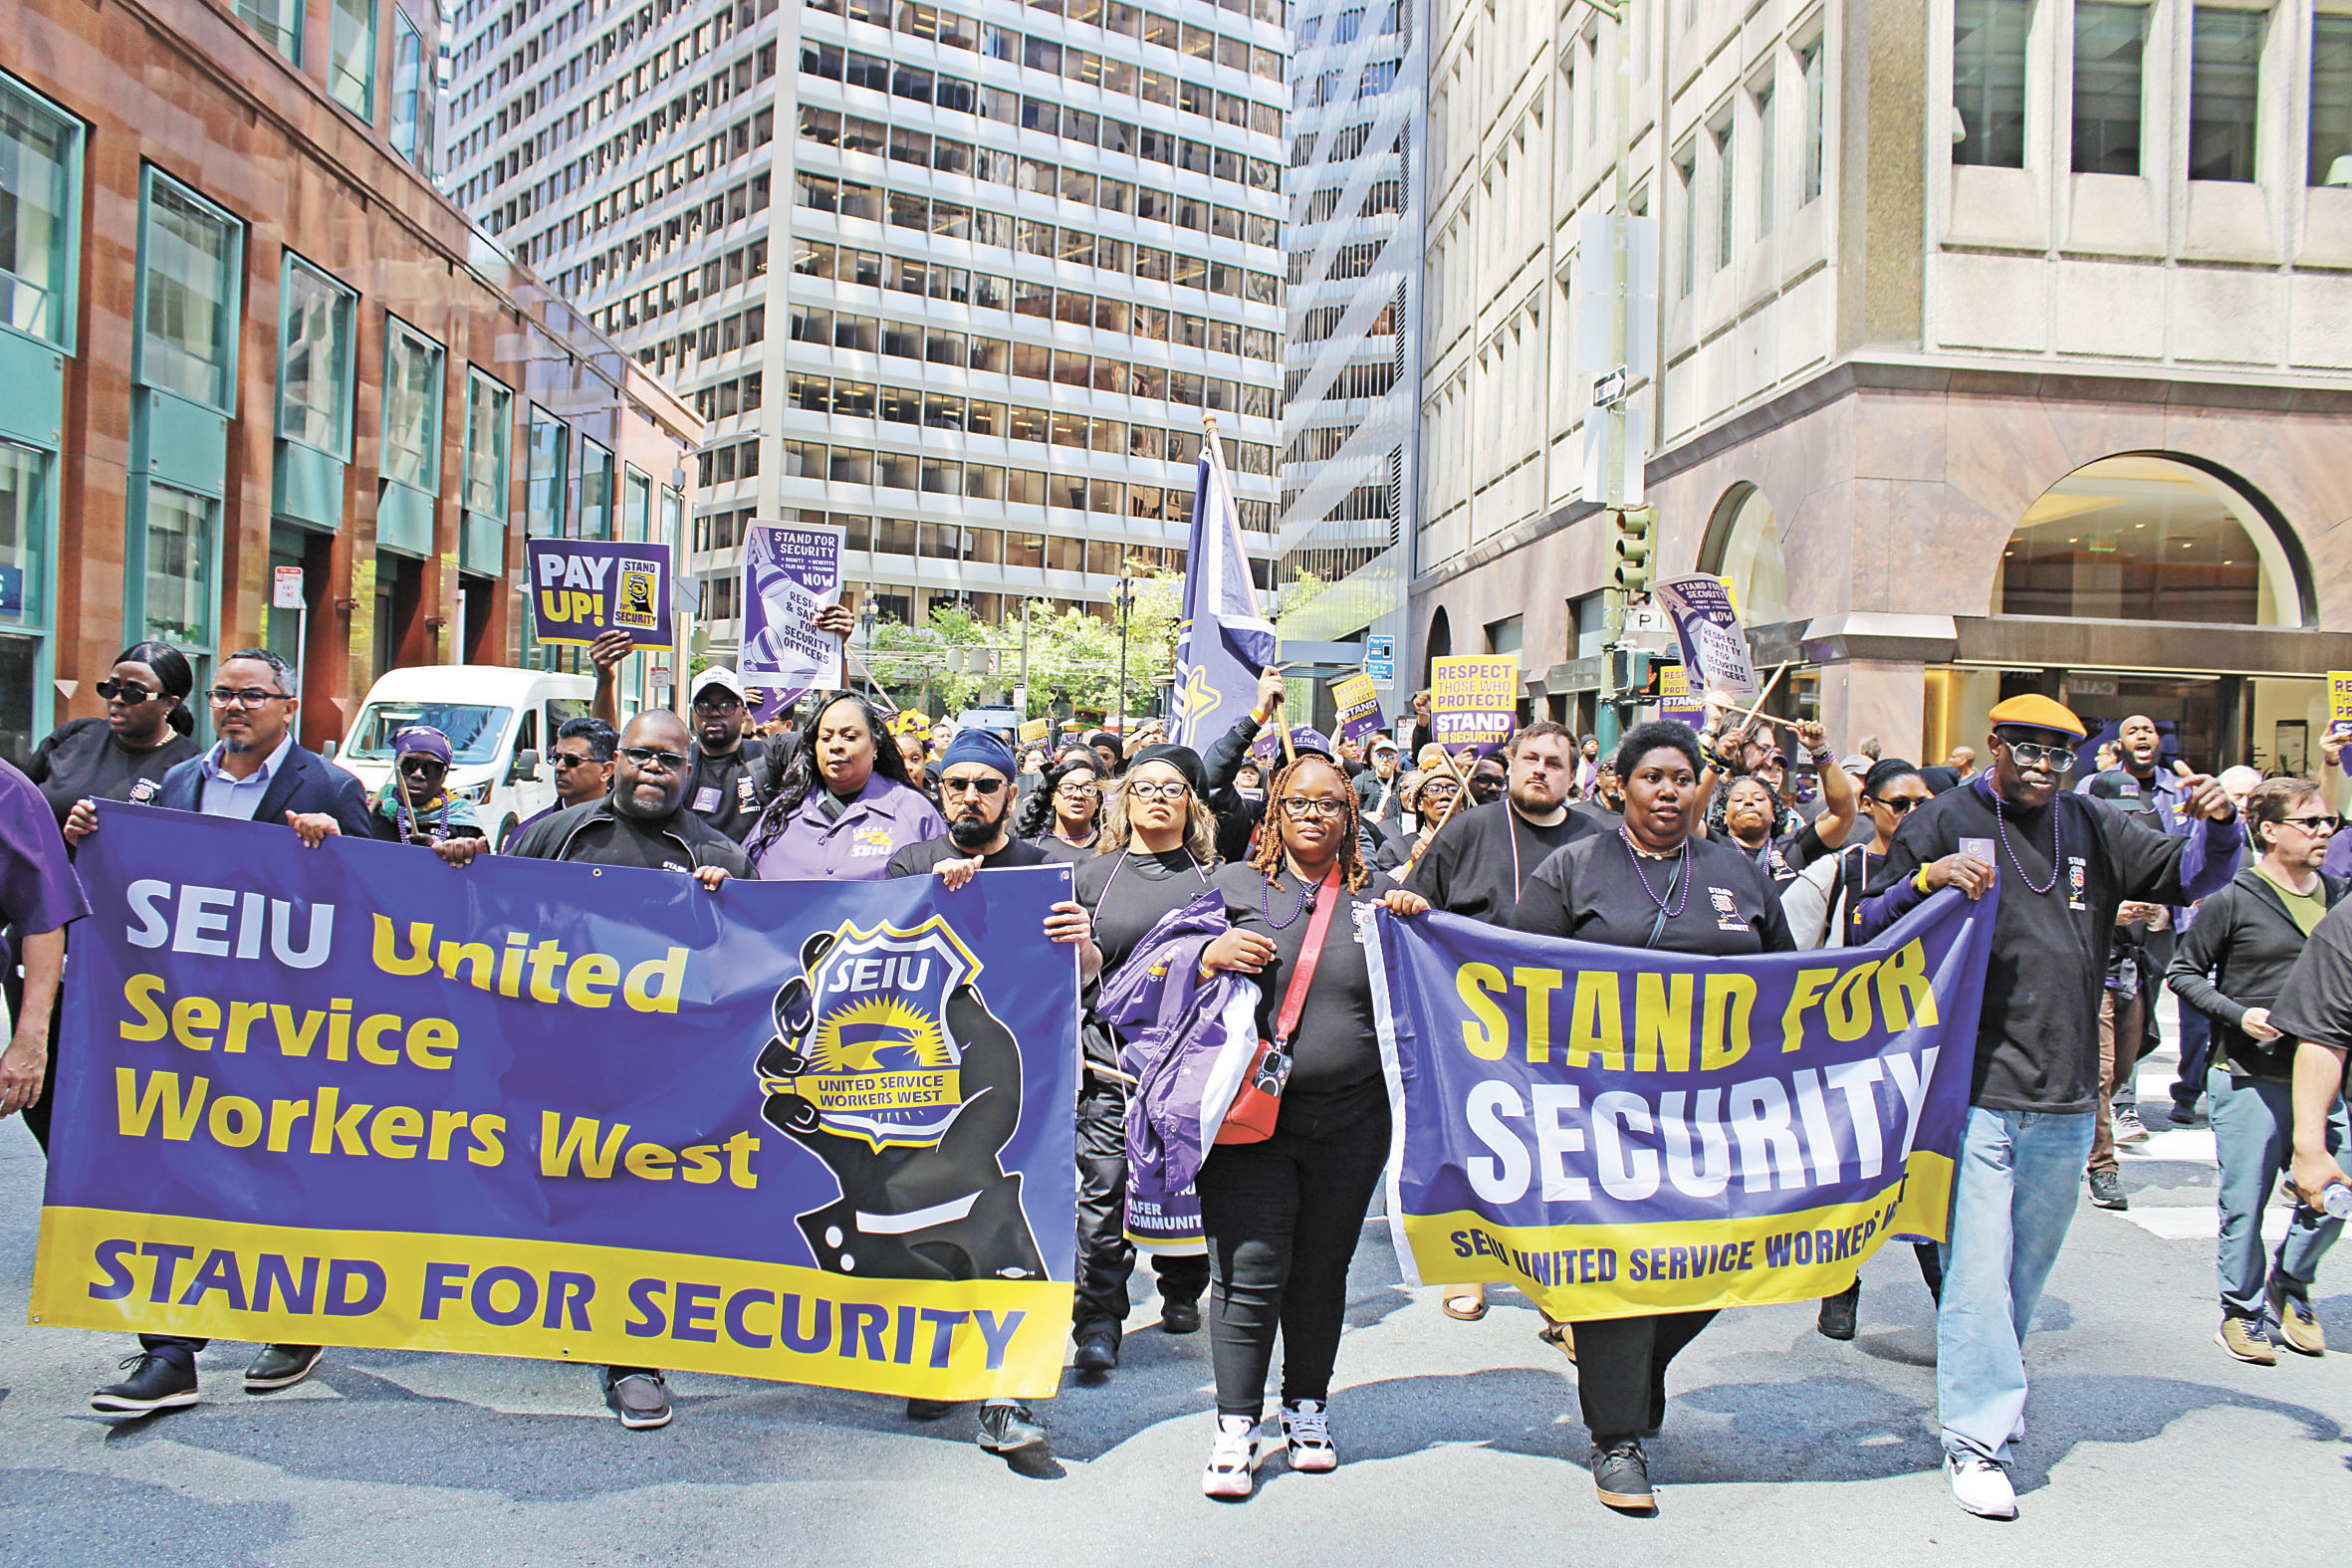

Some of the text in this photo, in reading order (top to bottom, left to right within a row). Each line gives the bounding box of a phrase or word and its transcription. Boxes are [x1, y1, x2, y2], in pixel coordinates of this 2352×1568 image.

[774, 531, 835, 547] STAND FOR
[780, 544, 834, 559] SECURITY
[538, 554, 613, 590] PAY
[624, 560, 655, 573] STAND
[803, 572, 834, 587] NOW
[1677, 581, 1707, 591] STAND
[1686, 590, 1726, 599] SECURITY
[541, 590, 605, 627] UP!
[787, 601, 794, 612] &
[614, 610, 656, 626] SECURITY
[1709, 611, 1733, 622] NOW
[800, 619, 817, 635] FOR
[785, 624, 830, 653] SECURITY
[1704, 627, 1737, 646] RESPECT
[784, 636, 829, 665] OFFICERS
[1710, 639, 1741, 656] SAFETY
[1437, 664, 1513, 680] RESPECT
[1707, 654, 1744, 673] SECURITY
[1664, 671, 1686, 680] RESP
[1708, 664, 1747, 682] OFFICERS
[1336, 678, 1368, 695] RESPECT
[1438, 680, 1511, 693] THOSE WHO
[1345, 700, 1377, 717] STAND
[1438, 694, 1511, 708] PROTECT!
[1436, 713, 1511, 732] STAND
[1450, 730, 1510, 744] SECURITY
[851, 845, 892, 857] SEIU
[126, 879, 689, 1013] SEIU United
[826, 957, 931, 993] SEIU
[1455, 936, 1941, 1072] STAND FOR
[119, 973, 459, 1070] Service
[818, 1074, 944, 1093] UNITED SERVICE
[820, 1090, 943, 1107] WORKERS WEST
[116, 1067, 761, 1189] Workers West
[1465, 1045, 1941, 1205] SECURITY
[1450, 1229, 1510, 1266] SEIU
[1512, 1248, 1617, 1287] UNITED
[1629, 1240, 1756, 1282] SERVICE
[89, 1238, 1027, 1371] STAND FOR SECURITY
